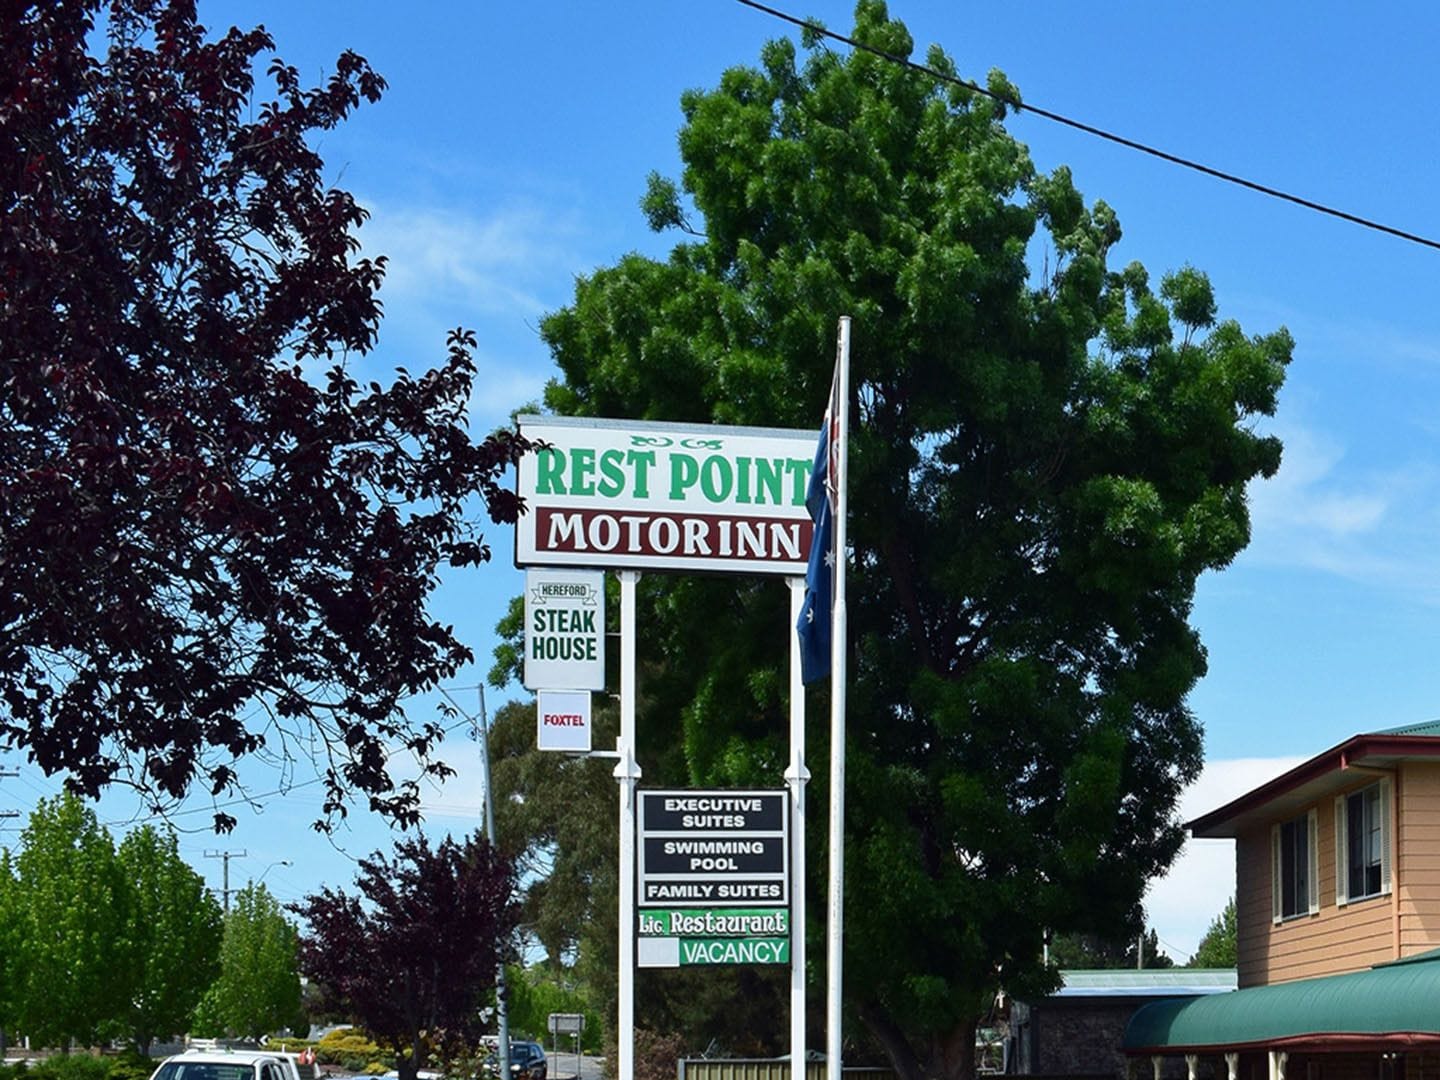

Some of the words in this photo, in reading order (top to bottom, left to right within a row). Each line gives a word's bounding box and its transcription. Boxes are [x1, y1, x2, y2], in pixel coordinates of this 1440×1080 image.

[535, 448, 656, 498] REST
[668, 453, 814, 506] POINT
[541, 585, 587, 596] HEREFORD
[534, 609, 596, 633] STEAK
[532, 637, 597, 661] HOUSE
[544, 714, 585, 726] FOXTEL
[664, 799, 762, 811] EXECUTIVE
[682, 815, 745, 827] SUITES
[664, 842, 764, 854] SWIMMING
[690, 858, 738, 870] POOL
[648, 885, 713, 897] FAMILY
[718, 885, 780, 897] SUITES
[670, 912, 786, 933] Restaurant
[683, 942, 785, 963] VACANCY
